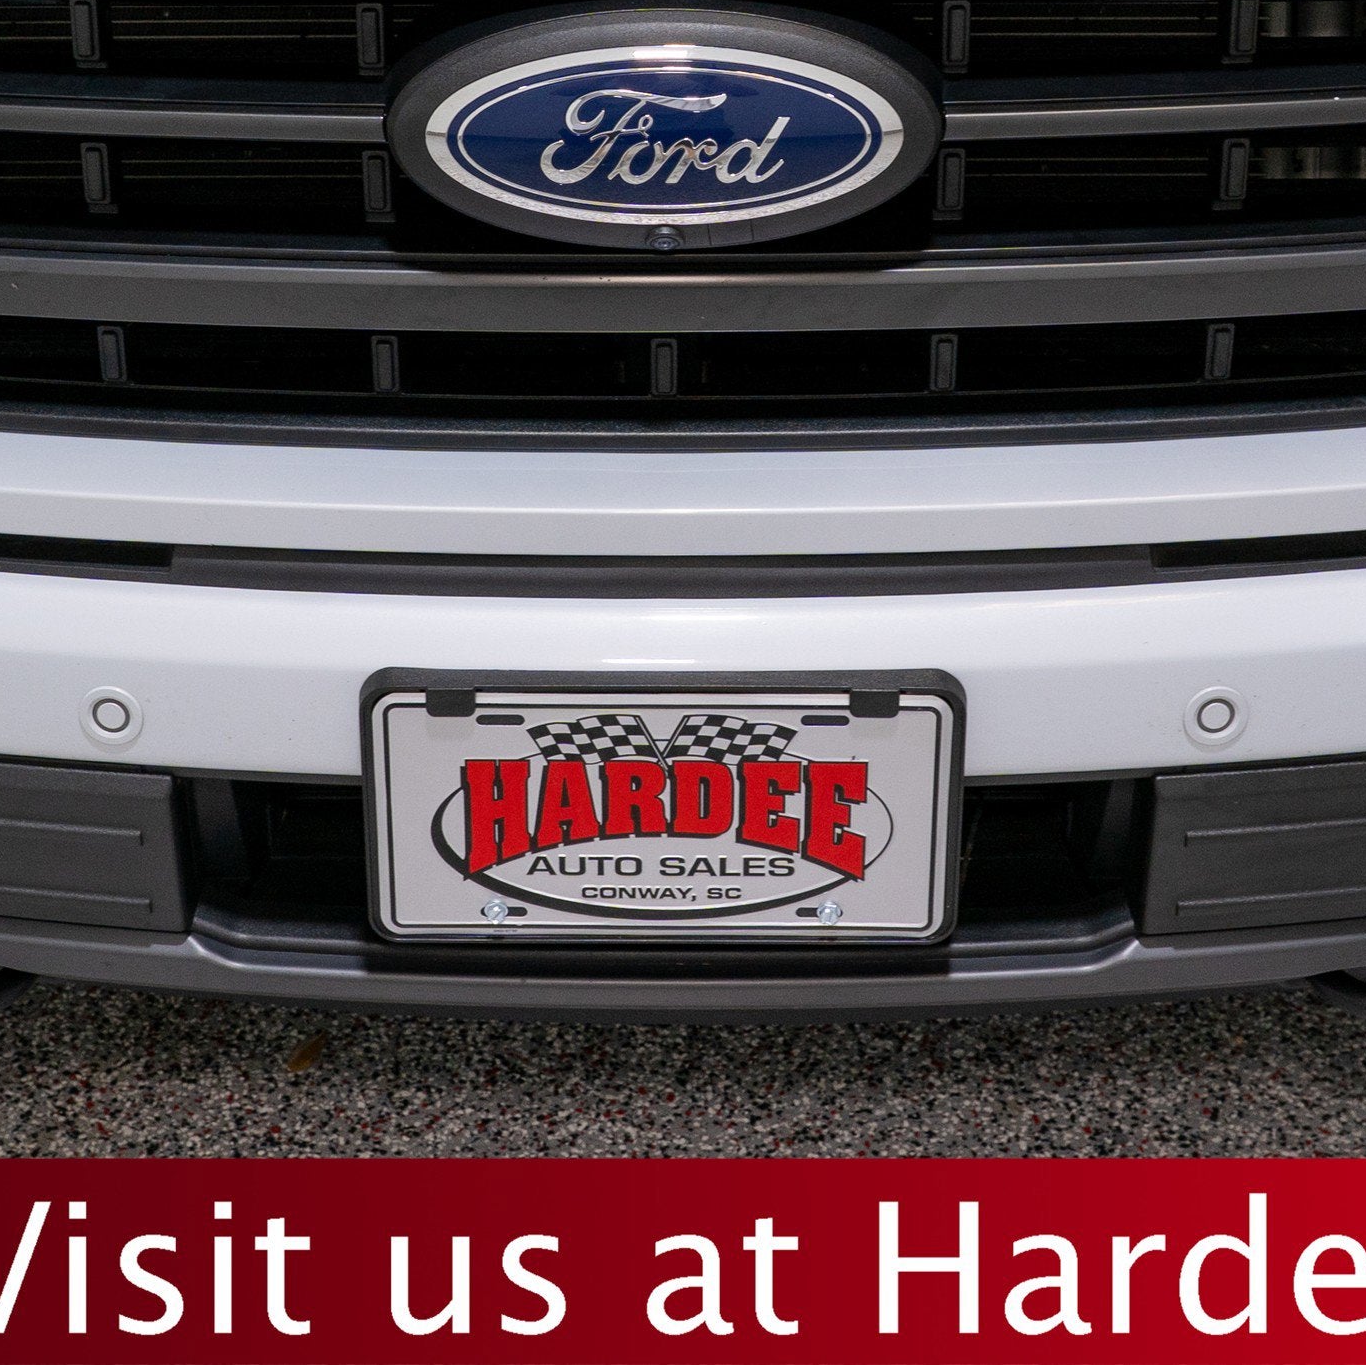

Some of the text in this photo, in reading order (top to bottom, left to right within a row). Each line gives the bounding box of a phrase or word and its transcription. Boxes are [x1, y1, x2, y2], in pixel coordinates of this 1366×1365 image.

[539, 88, 791, 185] Ford
[460, 758, 870, 881] HARDEE
[526, 856, 796, 878] AUTO SALES
[581, 886, 743, 902] CONWAY, SC
